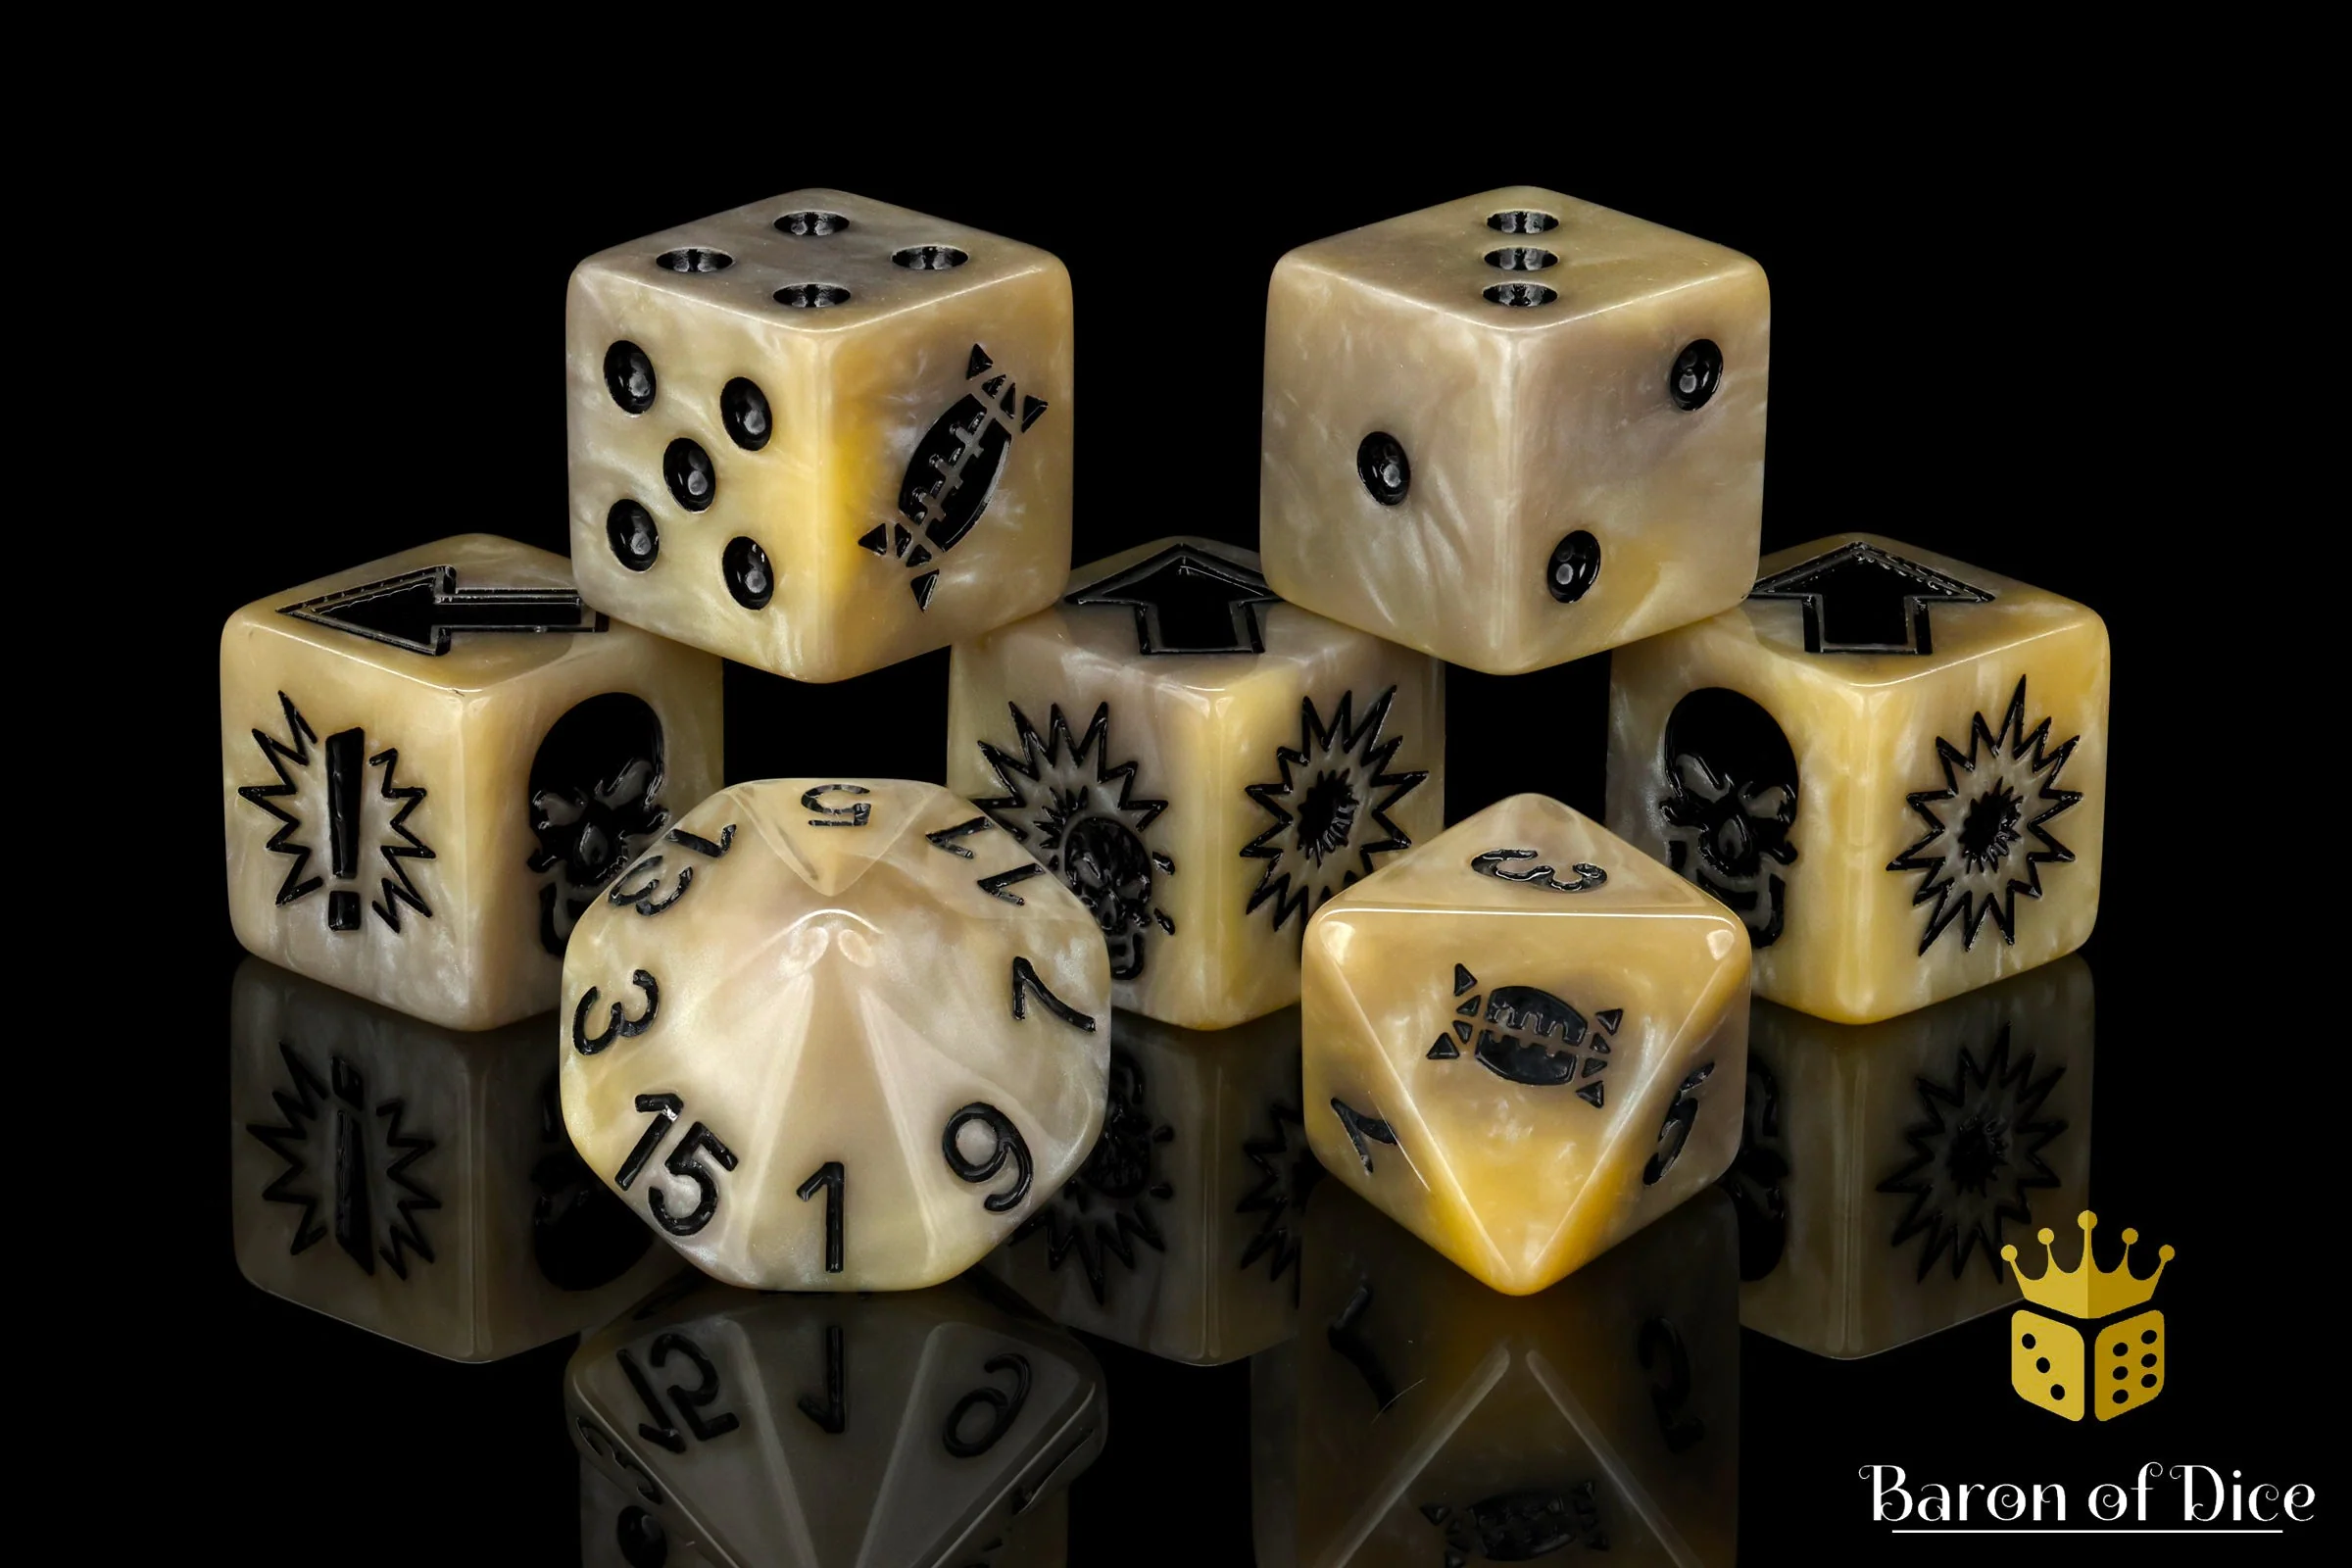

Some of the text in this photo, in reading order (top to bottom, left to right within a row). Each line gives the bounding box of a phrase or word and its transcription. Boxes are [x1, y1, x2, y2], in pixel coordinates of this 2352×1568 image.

[800, 783, 872, 827] 5
[607, 823, 738, 917] 13
[925, 816, 1046, 906] 11
[1470, 848, 1608, 893] 3
[571, 968, 660, 1056] 3
[1011, 956, 1097, 1033] 7
[613, 1092, 739, 1237] 15
[941, 1101, 1034, 1213] 9
[795, 1160, 846, 1273] 1
